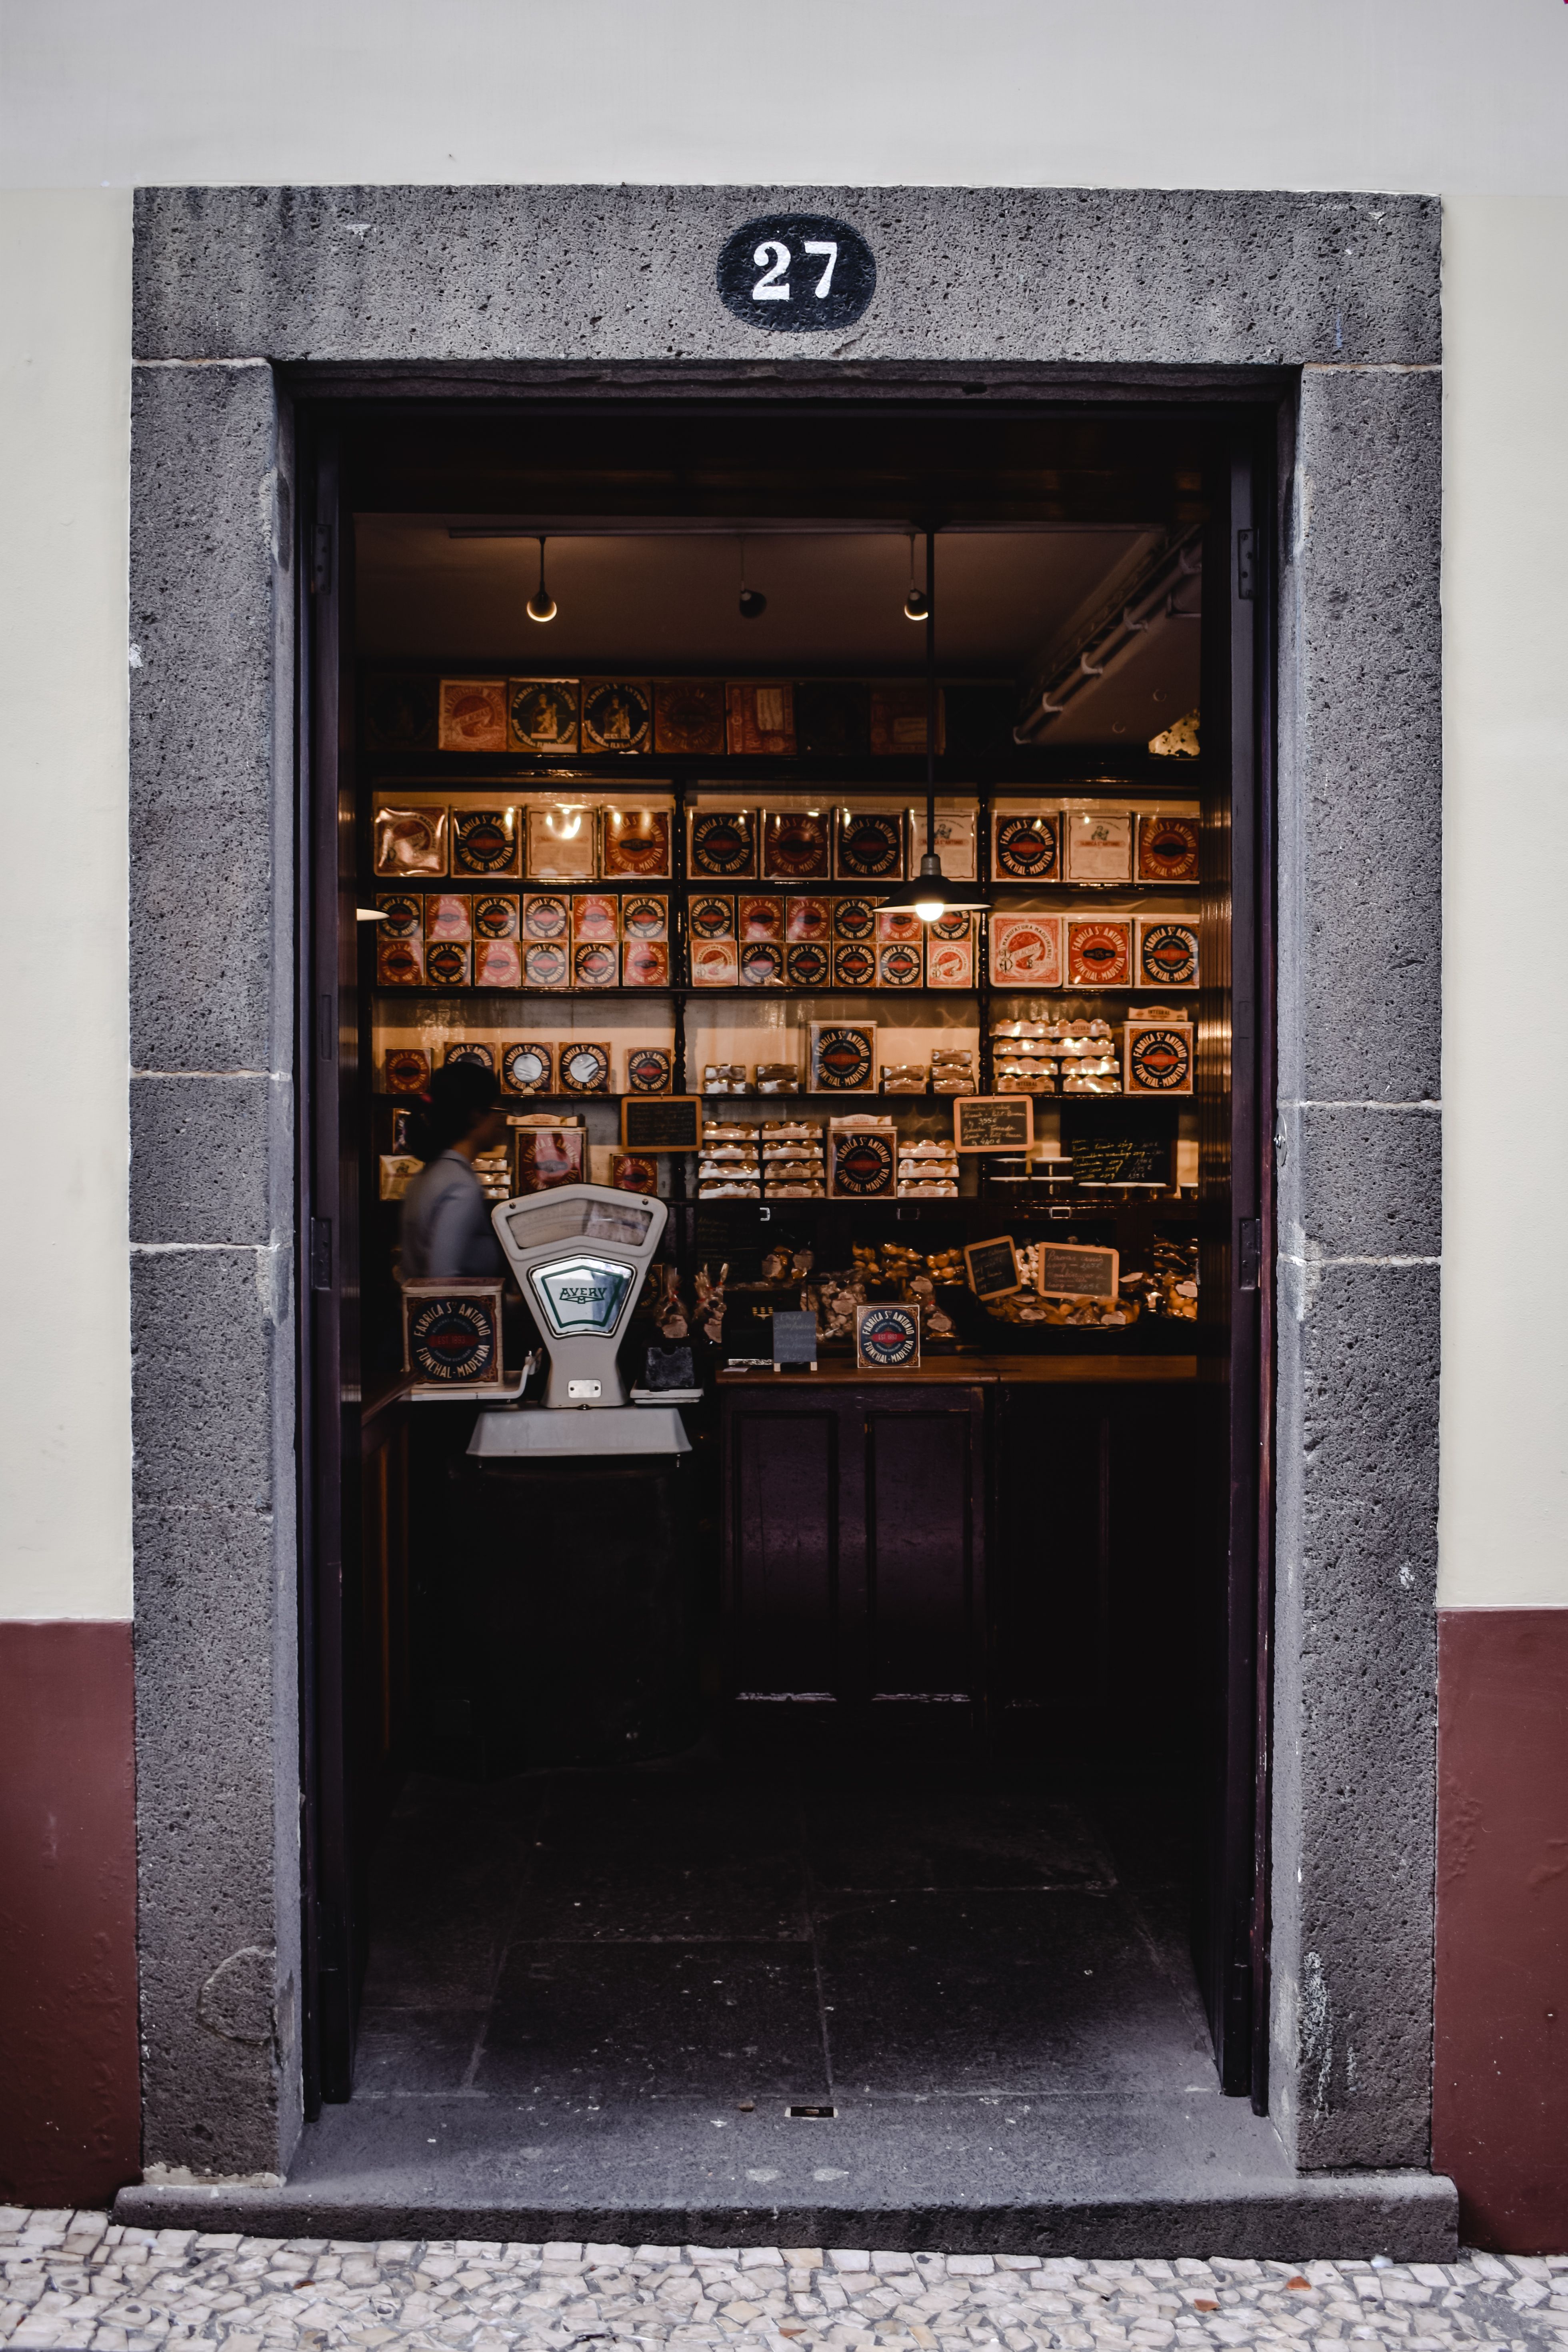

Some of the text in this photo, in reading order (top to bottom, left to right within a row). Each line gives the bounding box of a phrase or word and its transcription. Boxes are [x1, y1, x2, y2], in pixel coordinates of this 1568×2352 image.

[753, 242, 837, 300] 27
[458, 817, 480, 840] FABRICA
[695, 818, 750, 842] FABRICA ANTONIO
[842, 820, 896, 844] FABRICA ANTONIO
[1000, 821, 1021, 844] FABRICA
[1142, 823, 1196, 847] FABRICA ANTONIO
[460, 847, 513, 870] FUNCHAL MADEIRA
[610, 848, 663, 871] FUNCHAL MADEIRA
[696, 849, 749, 872] FUNCHAL MADEIRA
[843, 850, 896, 873] FUNCHAL MADEIRA
[1002, 852, 1025, 874] FUNCHAL
[1029, 851, 1053, 874] MADEIRA
[1144, 853, 1167, 876] FUNCHAL
[1172, 853, 1195, 875] MADEIRA
[1002, 924, 1052, 960] MANUFATURA MADEIRENSE
[1072, 928, 1093, 950] FABRICA
[1103, 928, 1125, 951] ANTONIO
[1144, 928, 1166, 951] FABRICA
[1176, 928, 1198, 952] ANTONIO
[788, 946, 804, 962] FABRICA
[836, 947, 874, 963] FABRICA ANTONIO
[881, 947, 896, 963] FABRICA
[809, 967, 826, 982] MADEIRA
[837, 968, 873, 984] FUNCHAL MADEIRA
[902, 968, 918, 983] MADEIRA
[1074, 958, 1124, 980] FUNCHAL MADEIRA
[1146, 958, 1169, 981] FUNCHAL
[814, 1033, 836, 1056] FABRICA
[846, 1032, 869, 1056] ANTONIO
[1133, 1034, 1155, 1056] FABRICA
[1165, 1034, 1187, 1057] ANTONIO
[816, 1062, 868, 1086] FUNCHAL MADEIRA
[1135, 1064, 1186, 1087] FUNCHAL MADEIRA
[836, 1139, 858, 1162] FABRICA
[868, 1139, 890, 1162] ANTONIO
[837, 1169, 889, 1192] FUNCHAL MADEIRA
[559, 1288, 607, 1300] AVERY
[413, 1304, 444, 1336] FABRICA
[458, 1304, 490, 1336] ANTONIO
[862, 1312, 883, 1334] FABRICA
[893, 1312, 914, 1334] ANTONIO
[452, 1336, 465, 1344] 1893
[864, 1340, 913, 1363] FUNCHAL MADEIRA
[416, 1345, 490, 1378] FUNCHAL MADEIRA
